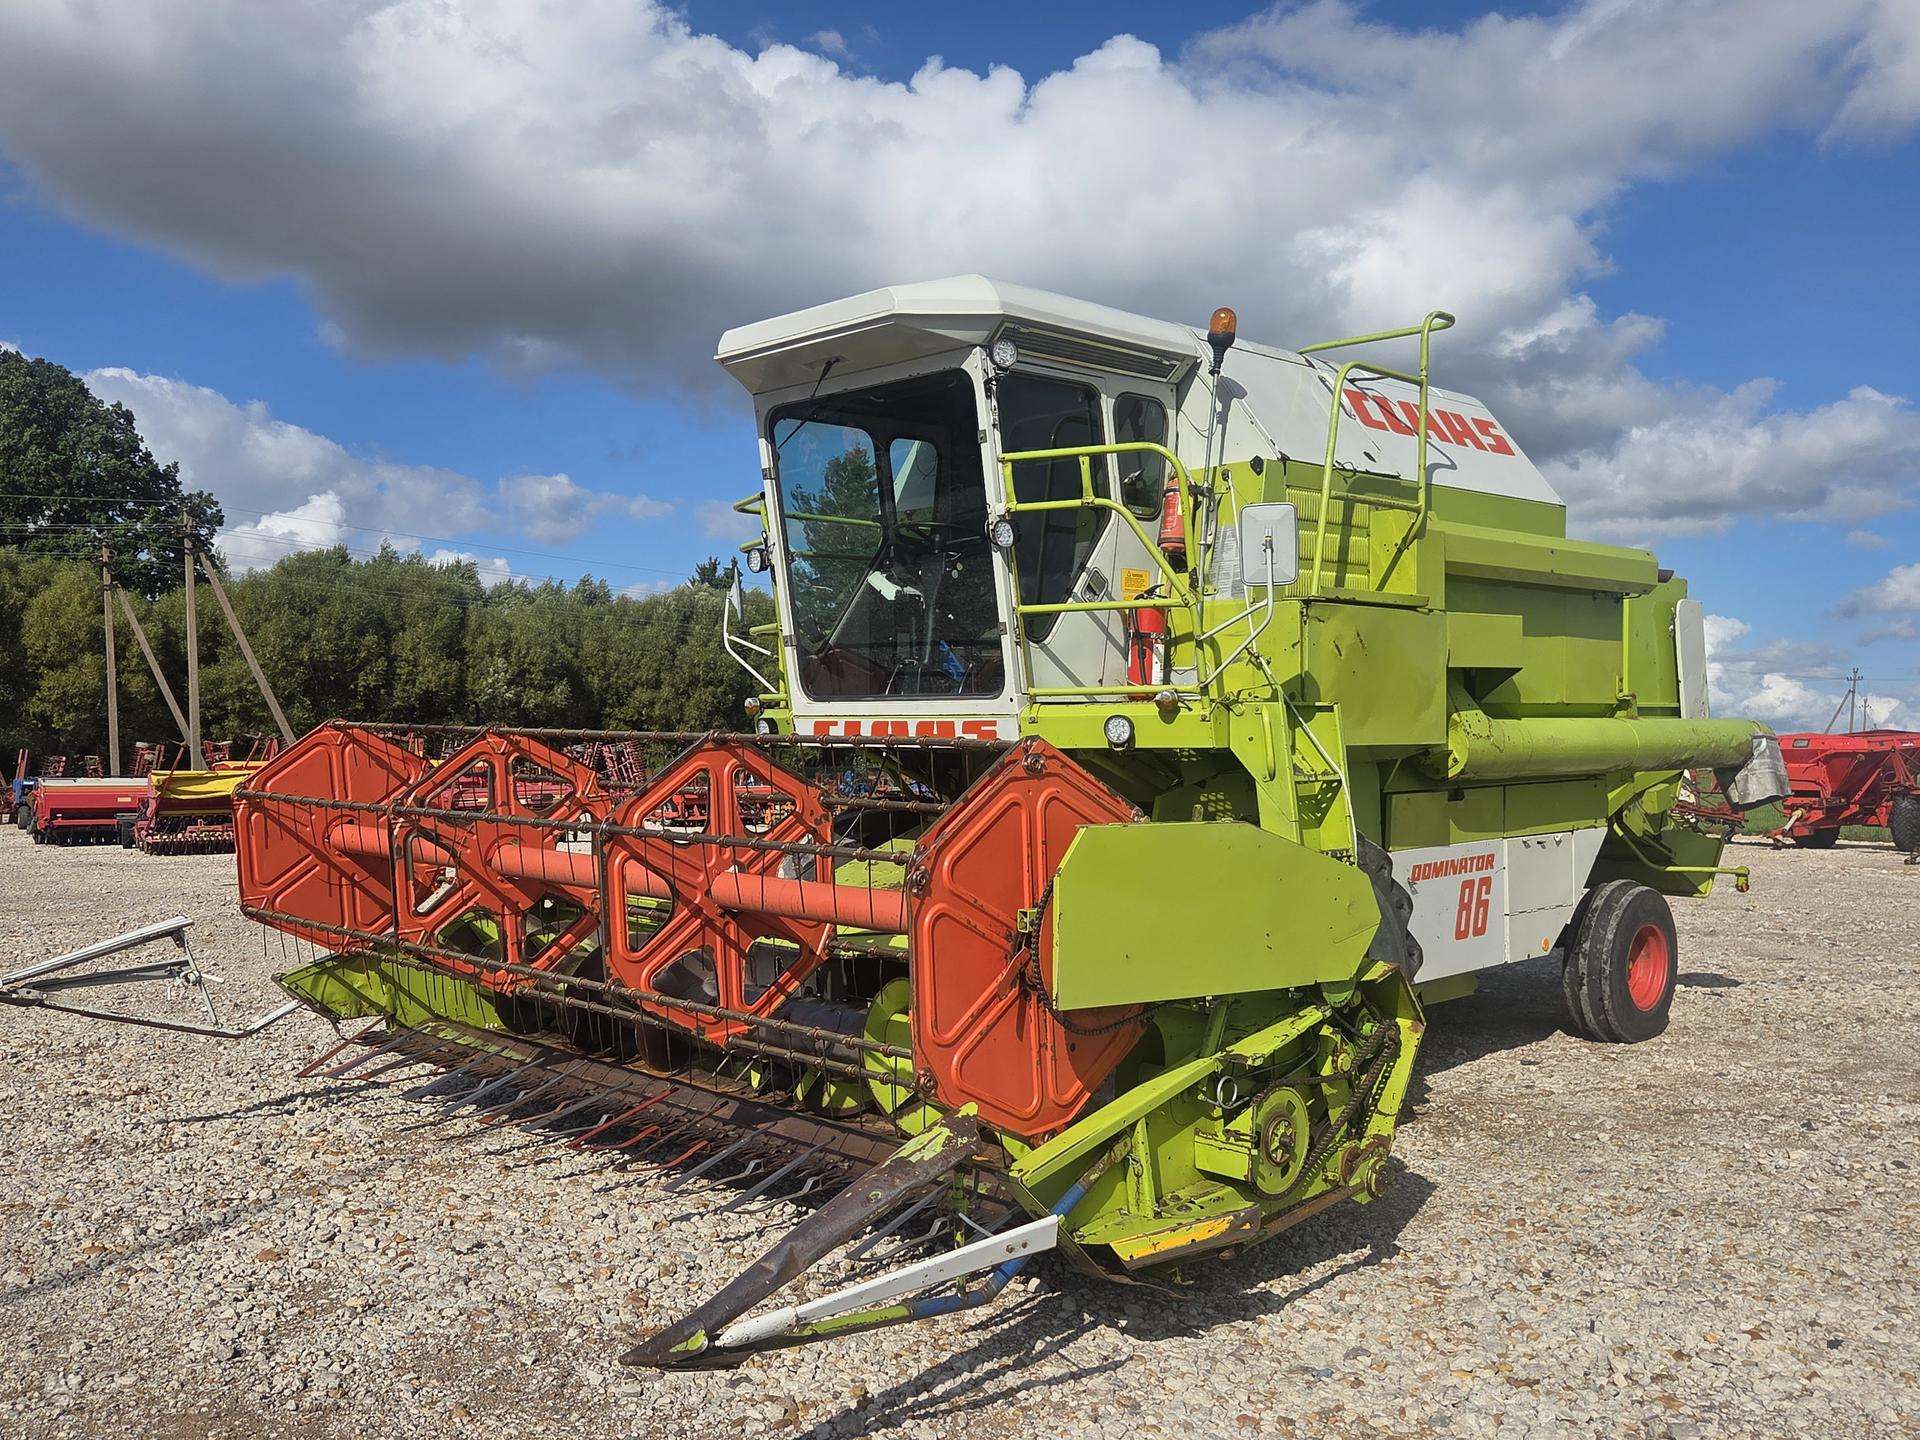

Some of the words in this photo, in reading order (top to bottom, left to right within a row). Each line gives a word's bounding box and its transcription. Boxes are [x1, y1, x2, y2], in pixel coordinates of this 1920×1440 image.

[1344, 389, 1515, 456] CLAAS
[1411, 853, 1495, 882] DOMINATOR
[1455, 876, 1492, 941] 86
